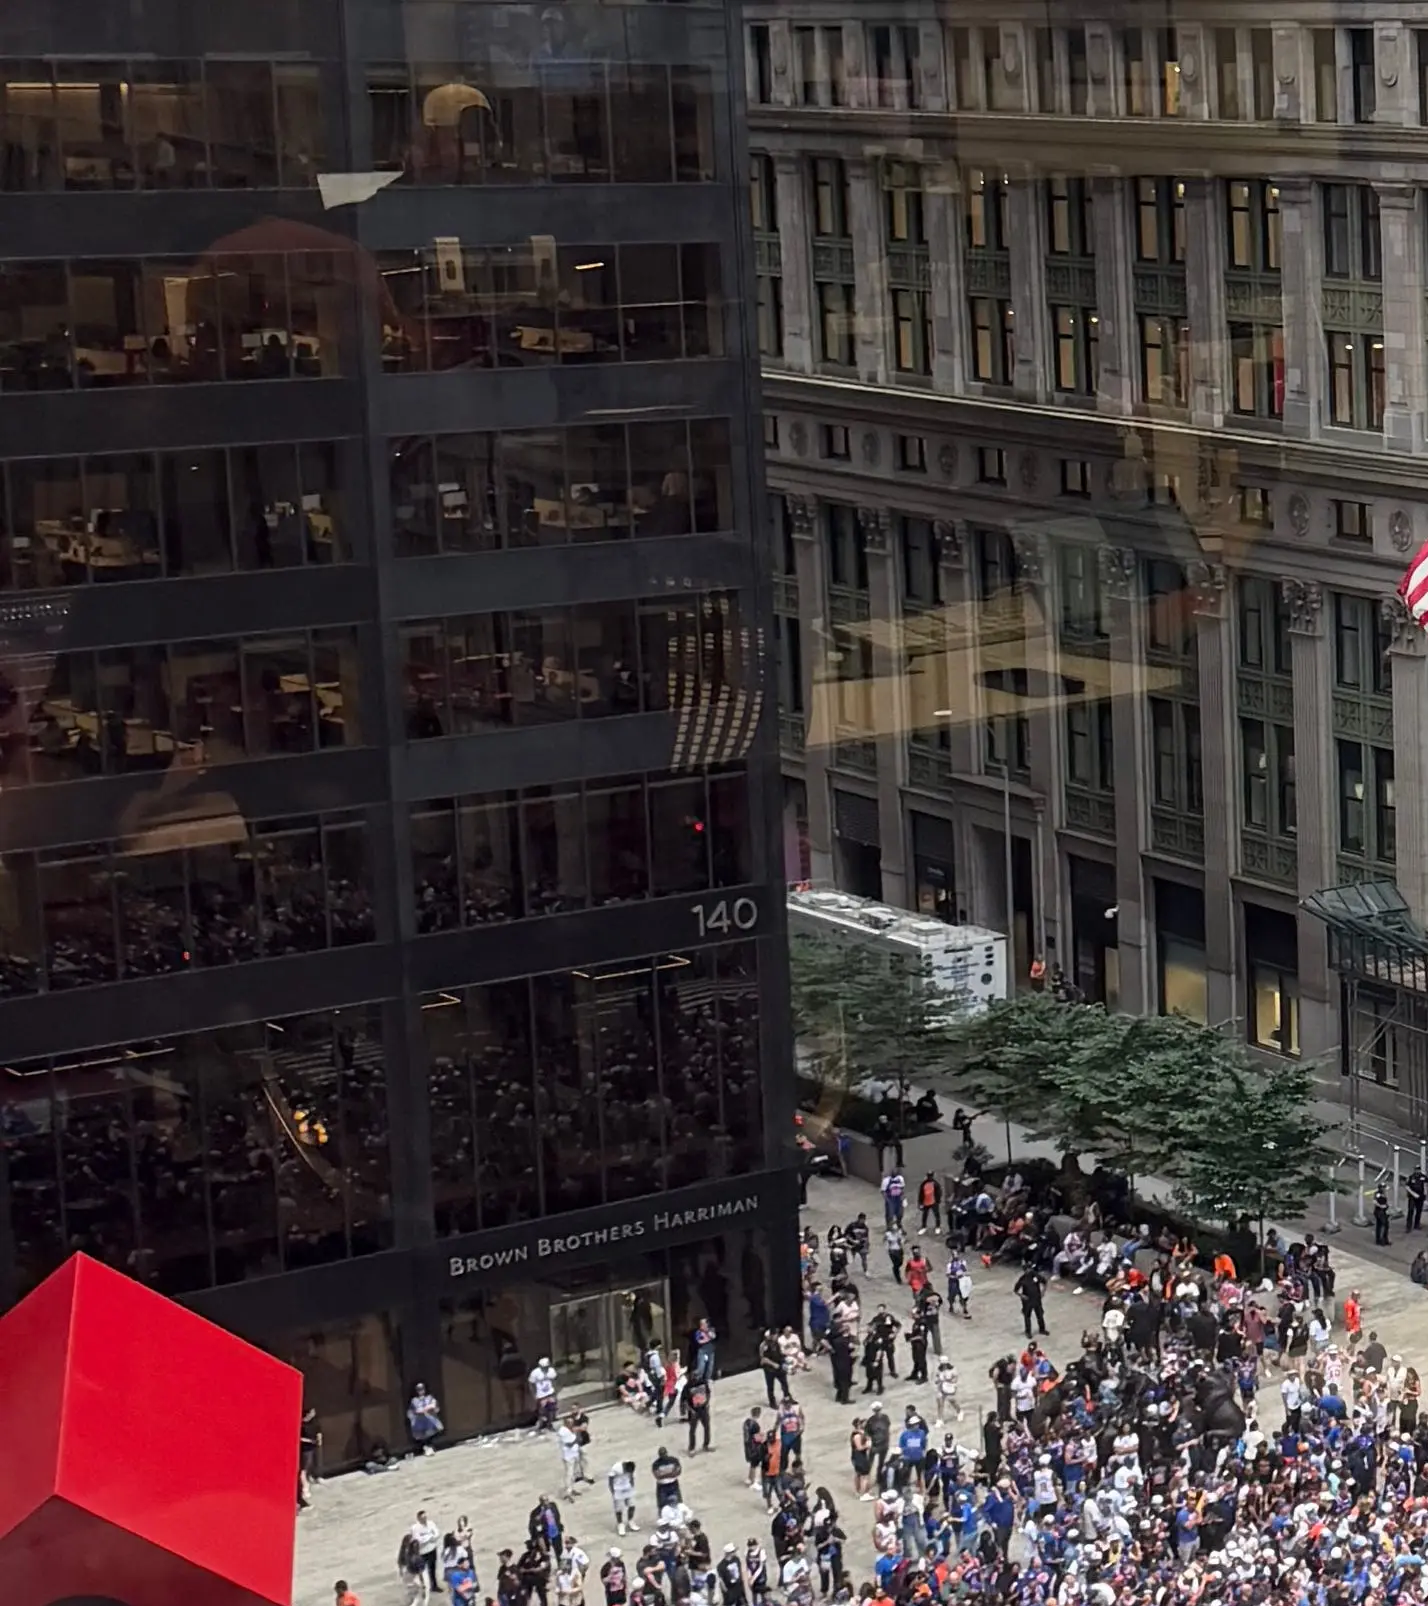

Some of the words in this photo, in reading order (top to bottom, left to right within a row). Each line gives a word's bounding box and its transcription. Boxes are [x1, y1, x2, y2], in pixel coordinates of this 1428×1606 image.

[691, 897, 758, 937] 140
[449, 1246, 528, 1277] BROWN
[538, 1219, 645, 1257] BROTHERS
[654, 1195, 759, 1232] HARRIMAN
